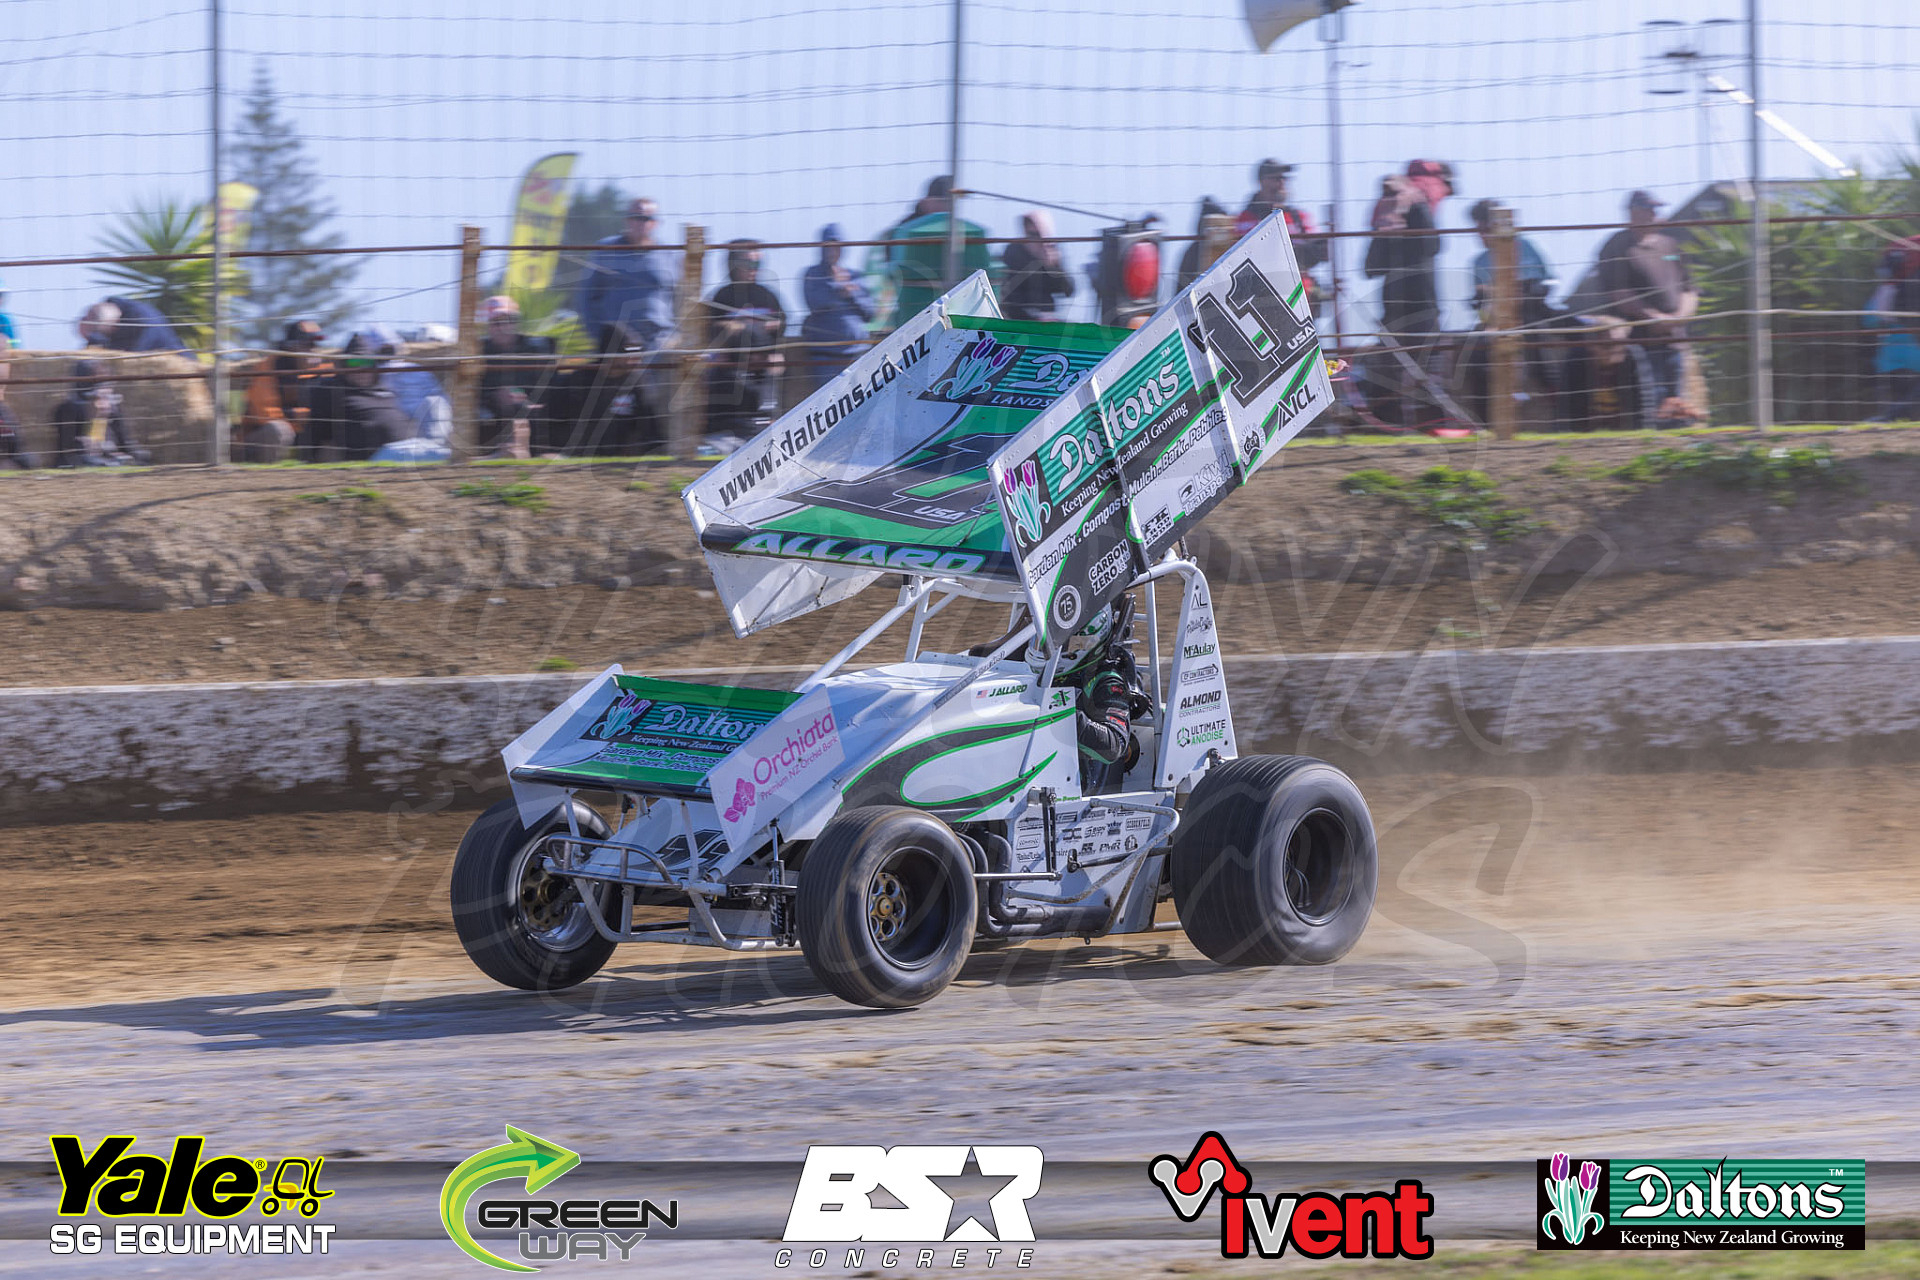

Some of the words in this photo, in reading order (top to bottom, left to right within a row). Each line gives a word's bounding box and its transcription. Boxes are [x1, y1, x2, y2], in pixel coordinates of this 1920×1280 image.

[1187, 257, 1319, 408] 11
[1287, 327, 1316, 351] USA
[718, 333, 930, 507] www.daltons.co.nz
[1050, 361, 1180, 494] Daltons
[1061, 480, 1099, 517] Keeping
[1096, 463, 1119, 489] New
[1118, 432, 1150, 469] Zealand
[1150, 402, 1189, 439] Growing
[1194, 452, 1230, 490] Kiwi
[1027, 552, 1059, 589] Garden
[1189, 406, 1228, 447] Pebbles
[1183, 466, 1234, 516] Transport
[914, 505, 966, 521] USA
[732, 532, 986, 574] ALLARD
[1089, 539, 1129, 581] CARBON
[1092, 565, 1118, 596] ZERO
[1061, 596, 1073, 614] 75
[1183, 642, 1216, 658] McAulay
[996, 684, 1028, 697] ALLARD
[1180, 690, 1221, 710] ALMOND
[644, 705, 766, 740] Dalton
[1179, 705, 1220, 718] CONTRACTORS
[1191, 719, 1226, 735] ULTIMATE
[631, 735, 669, 746] Keeping
[754, 712, 835, 784] Orchiata
[1191, 729, 1224, 745] ANODISE
[760, 775, 788, 800] Premium
[800, 749, 822, 768] Orchid
